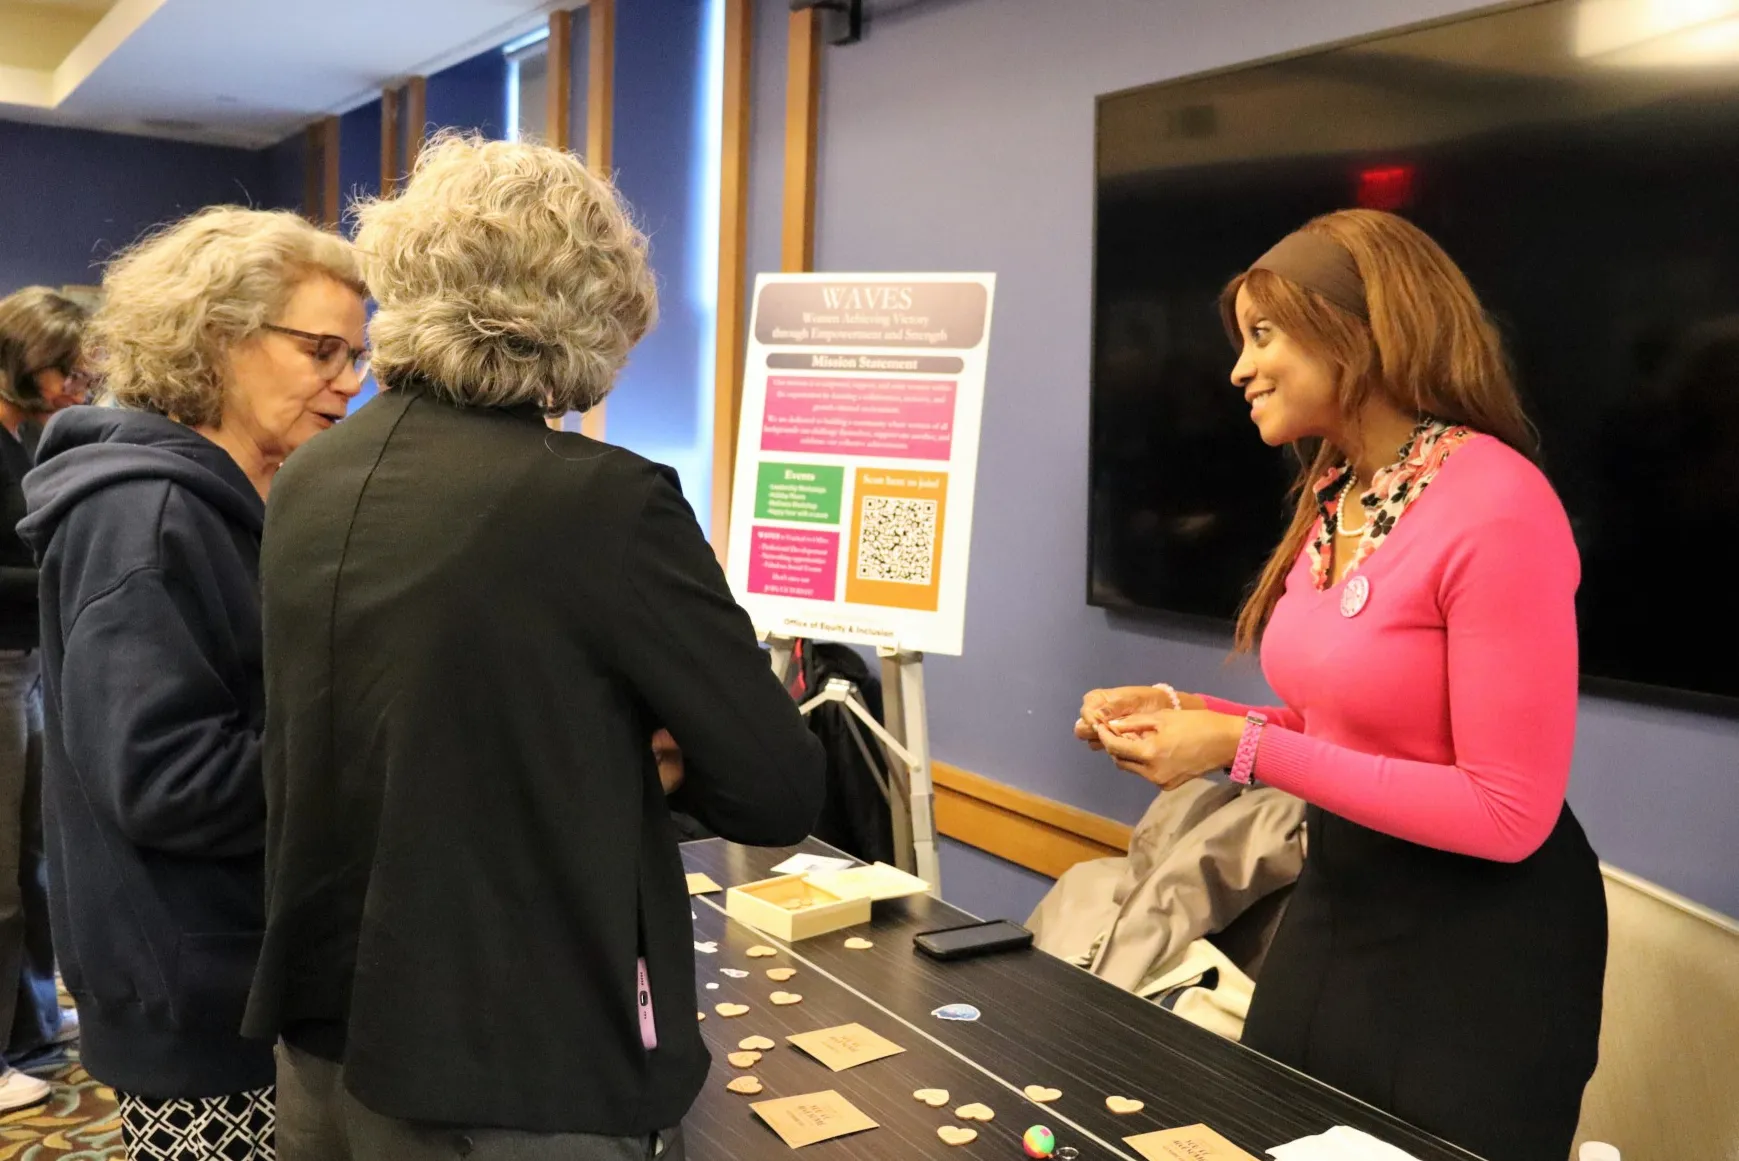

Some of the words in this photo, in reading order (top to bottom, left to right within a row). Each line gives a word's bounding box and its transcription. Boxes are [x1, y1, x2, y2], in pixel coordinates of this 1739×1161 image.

[822, 286, 913, 310] WAVES
[802, 312, 841, 324] Women
[843, 312, 890, 326] Achieving
[892, 313, 930, 327] Victory
[811, 328, 882, 342] Empowerment
[884, 329, 903, 340] and
[905, 329, 947, 343] Strength
[811, 355, 857, 369] Mission
[858, 356, 918, 370] Statement
[784, 469, 816, 482] Events
[784, 618, 807, 628] Office
[810, 621, 818, 629] of
[820, 622, 845, 634] Equity
[856, 626, 894, 637] Inclusion
